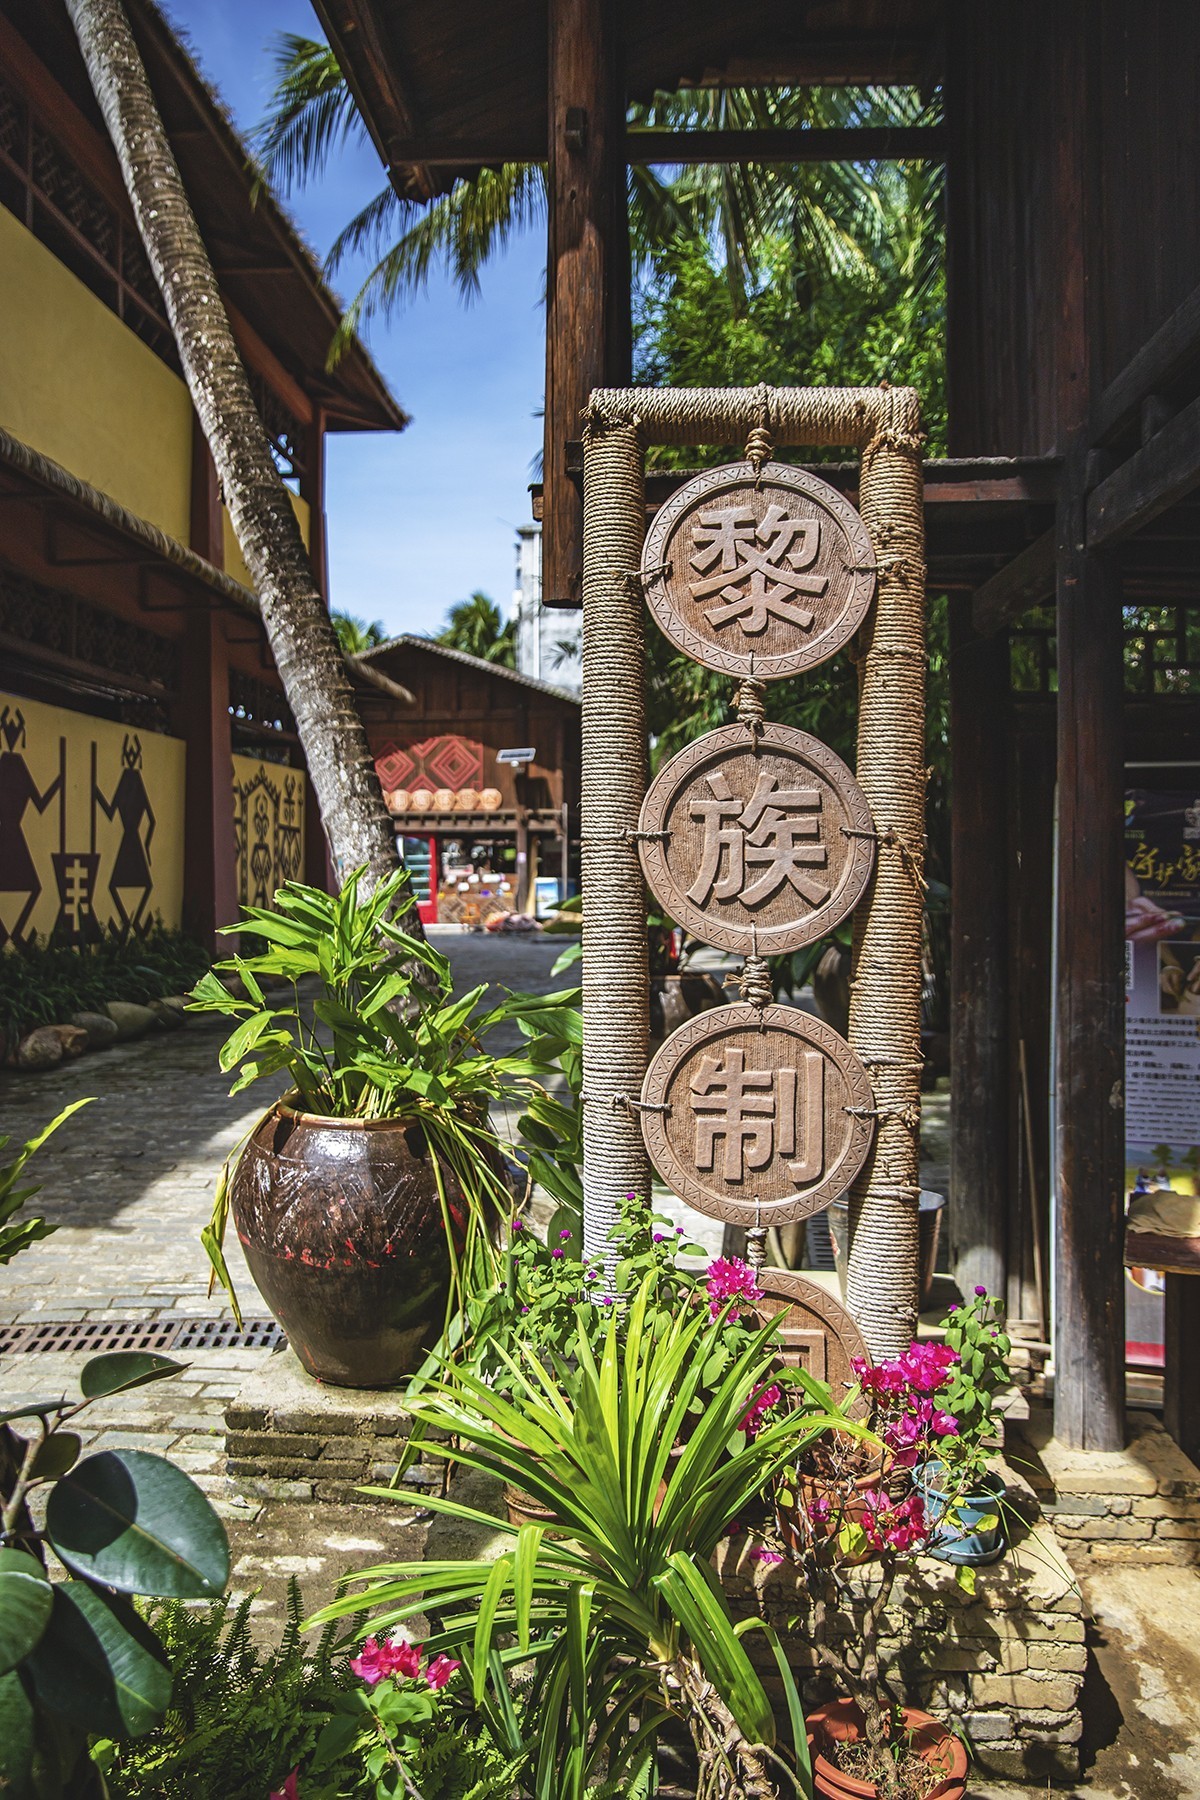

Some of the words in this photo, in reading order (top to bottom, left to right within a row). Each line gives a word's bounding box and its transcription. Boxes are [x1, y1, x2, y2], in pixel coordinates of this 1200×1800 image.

[689, 505, 828, 634] 黎
[687, 771, 831, 907] 族
[690, 1048, 825, 1183] 制
